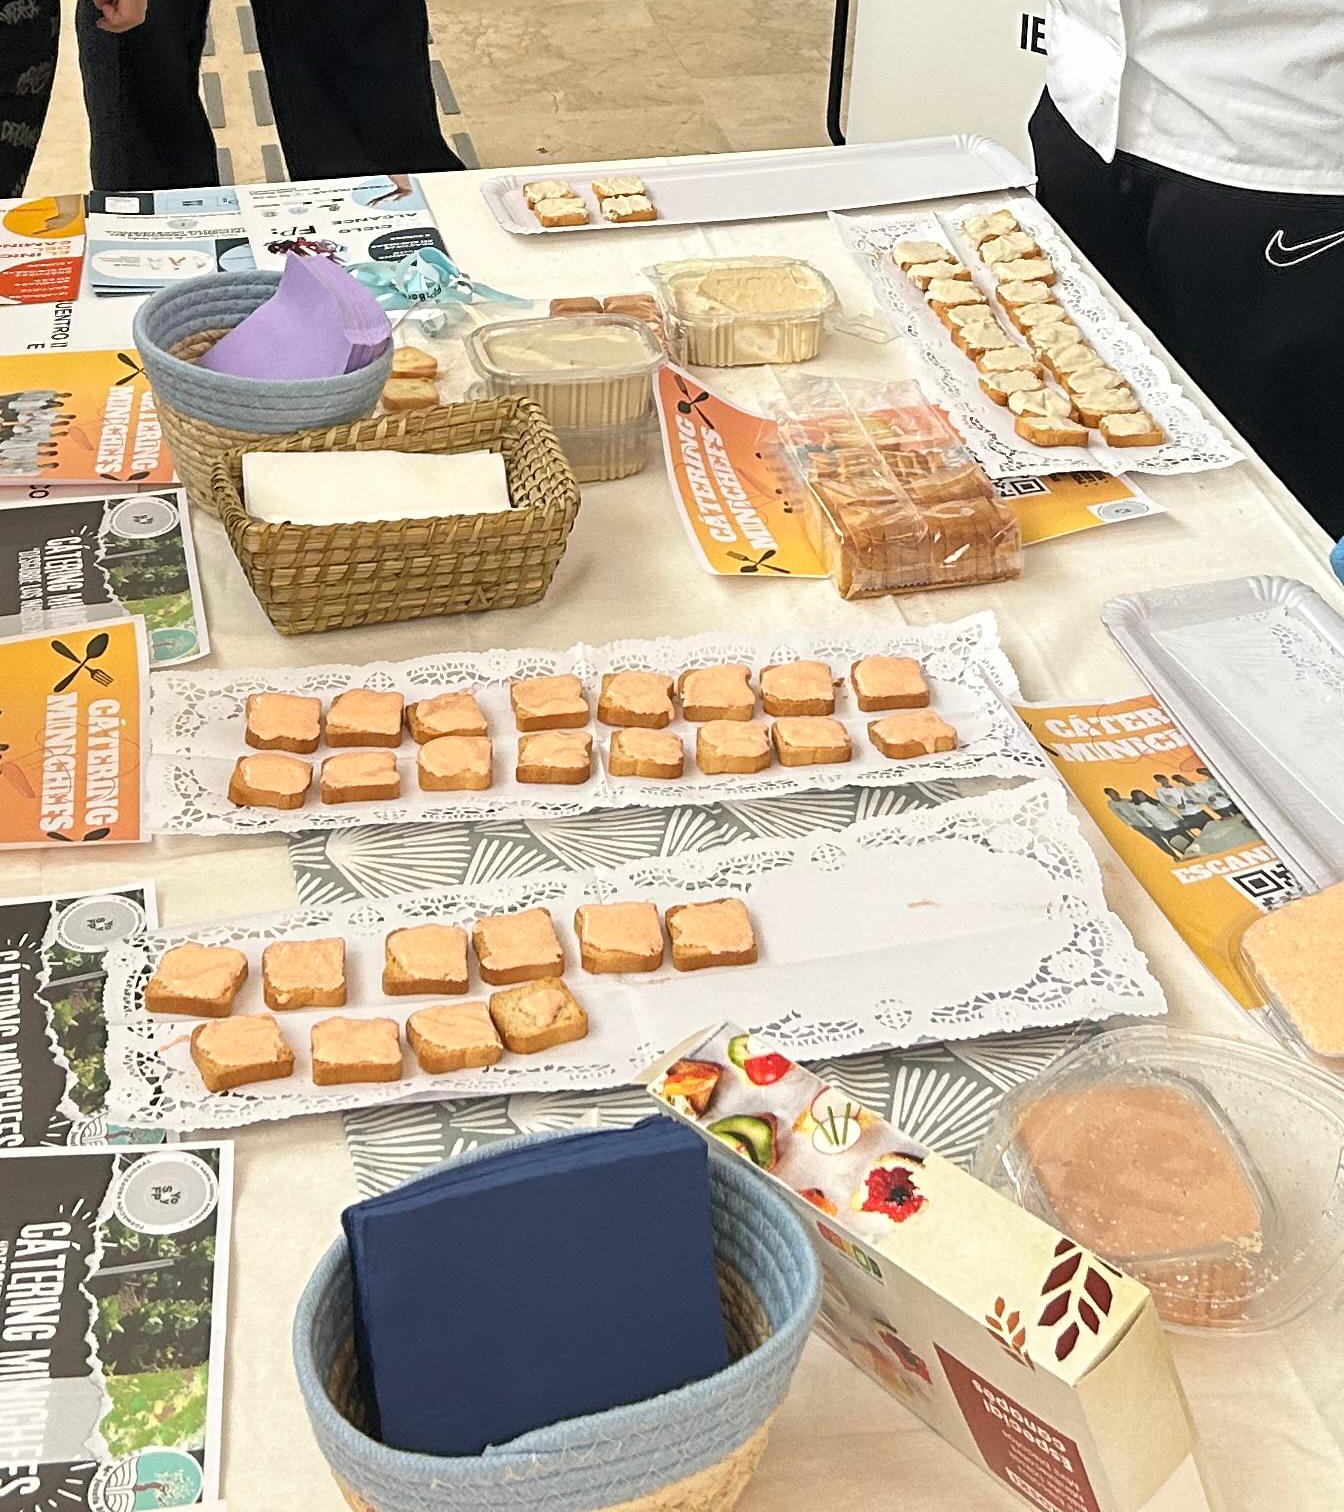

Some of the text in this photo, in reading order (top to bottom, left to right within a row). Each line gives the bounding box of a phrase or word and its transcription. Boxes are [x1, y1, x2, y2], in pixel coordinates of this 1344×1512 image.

[95, 385, 134, 474] MINICHEFS
[700, 425, 778, 550] MINICHEFS
[43, 536, 91, 592] CÁTERING
[39, 691, 78, 833] MINICHEFS
[85, 698, 127, 826] CÁTERING
[1044, 707, 1172, 738] CÁTER
[2, 1220, 81, 1342] CÁTERING
